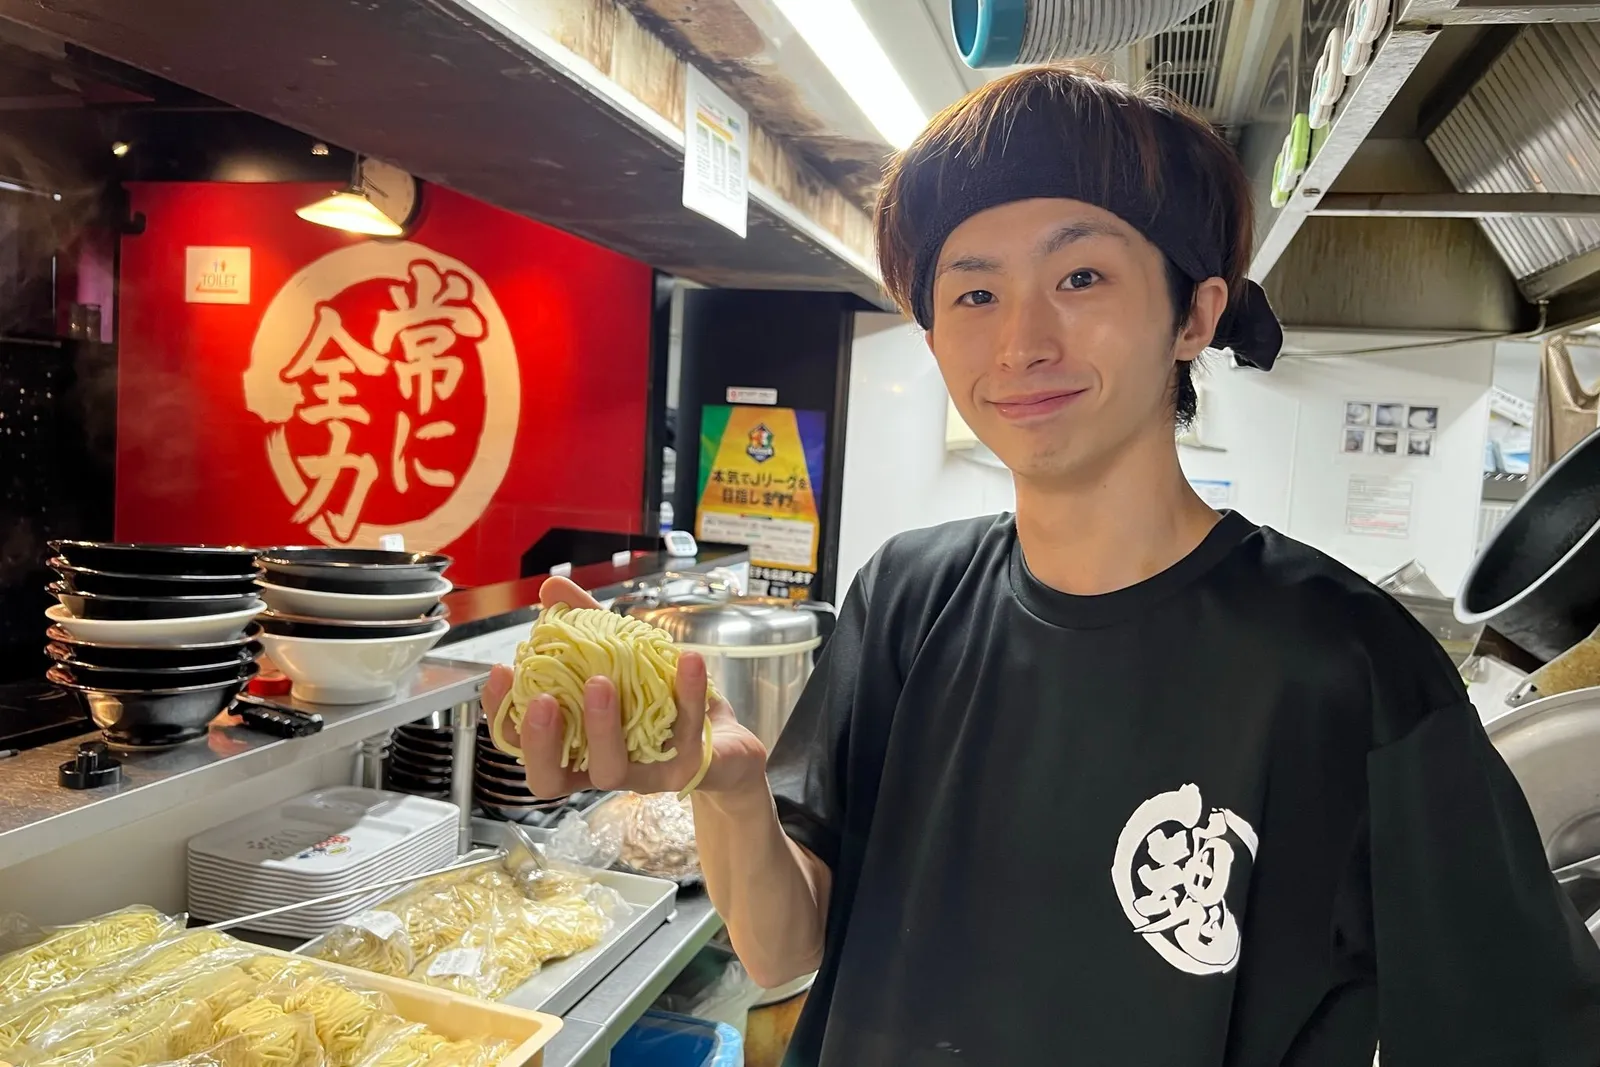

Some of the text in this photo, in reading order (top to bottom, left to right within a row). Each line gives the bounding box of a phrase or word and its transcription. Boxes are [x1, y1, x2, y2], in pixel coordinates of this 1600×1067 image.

[201, 273, 237, 287] TOILET
[373, 260, 487, 493] 常に
[283, 304, 388, 541] 全力
